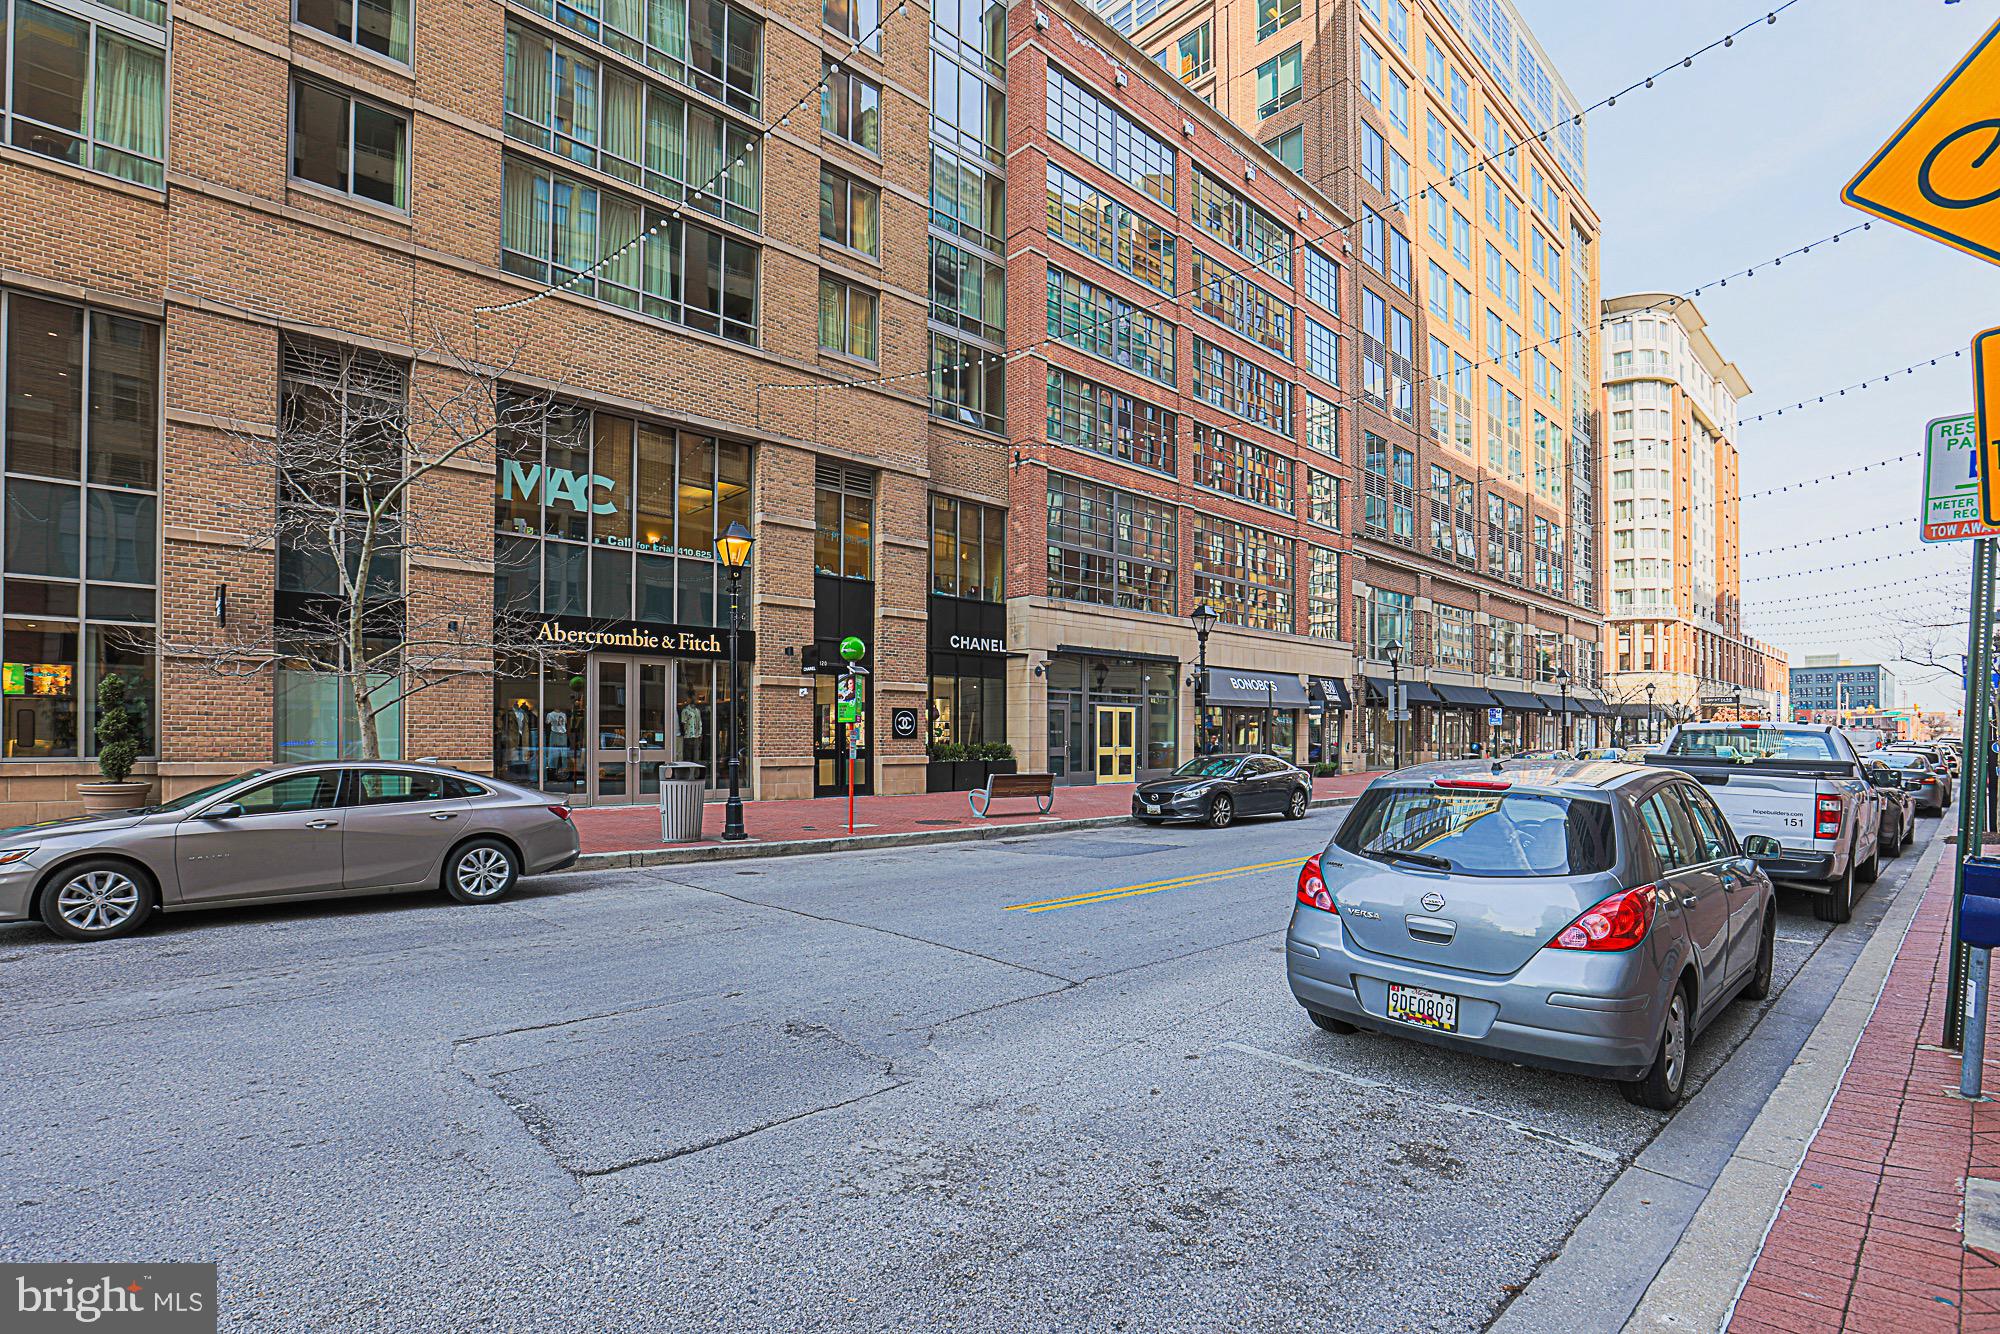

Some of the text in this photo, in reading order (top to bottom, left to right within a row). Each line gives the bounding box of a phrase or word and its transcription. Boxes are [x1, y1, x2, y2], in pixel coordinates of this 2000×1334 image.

[1946, 436, 1976, 451] PA
[502, 458, 618, 515] MAC
[1933, 498, 1974, 511] METER
[1930, 524, 1957, 537] TOW
[607, 535, 631, 548] Call
[636, 541, 650, 550] for
[652, 543, 674, 553] trial
[537, 622, 721, 652] Abercrombie & Fitch
[950, 635, 1007, 653] CHANEL
[1230, 677, 1278, 691] BONOBOS
[1752, 808, 1804, 817] hopebuilders.com
[1783, 818, 1803, 827] 151
[1347, 907, 1381, 920] VERSA
[1391, 992, 1453, 1020] 9DE0809
